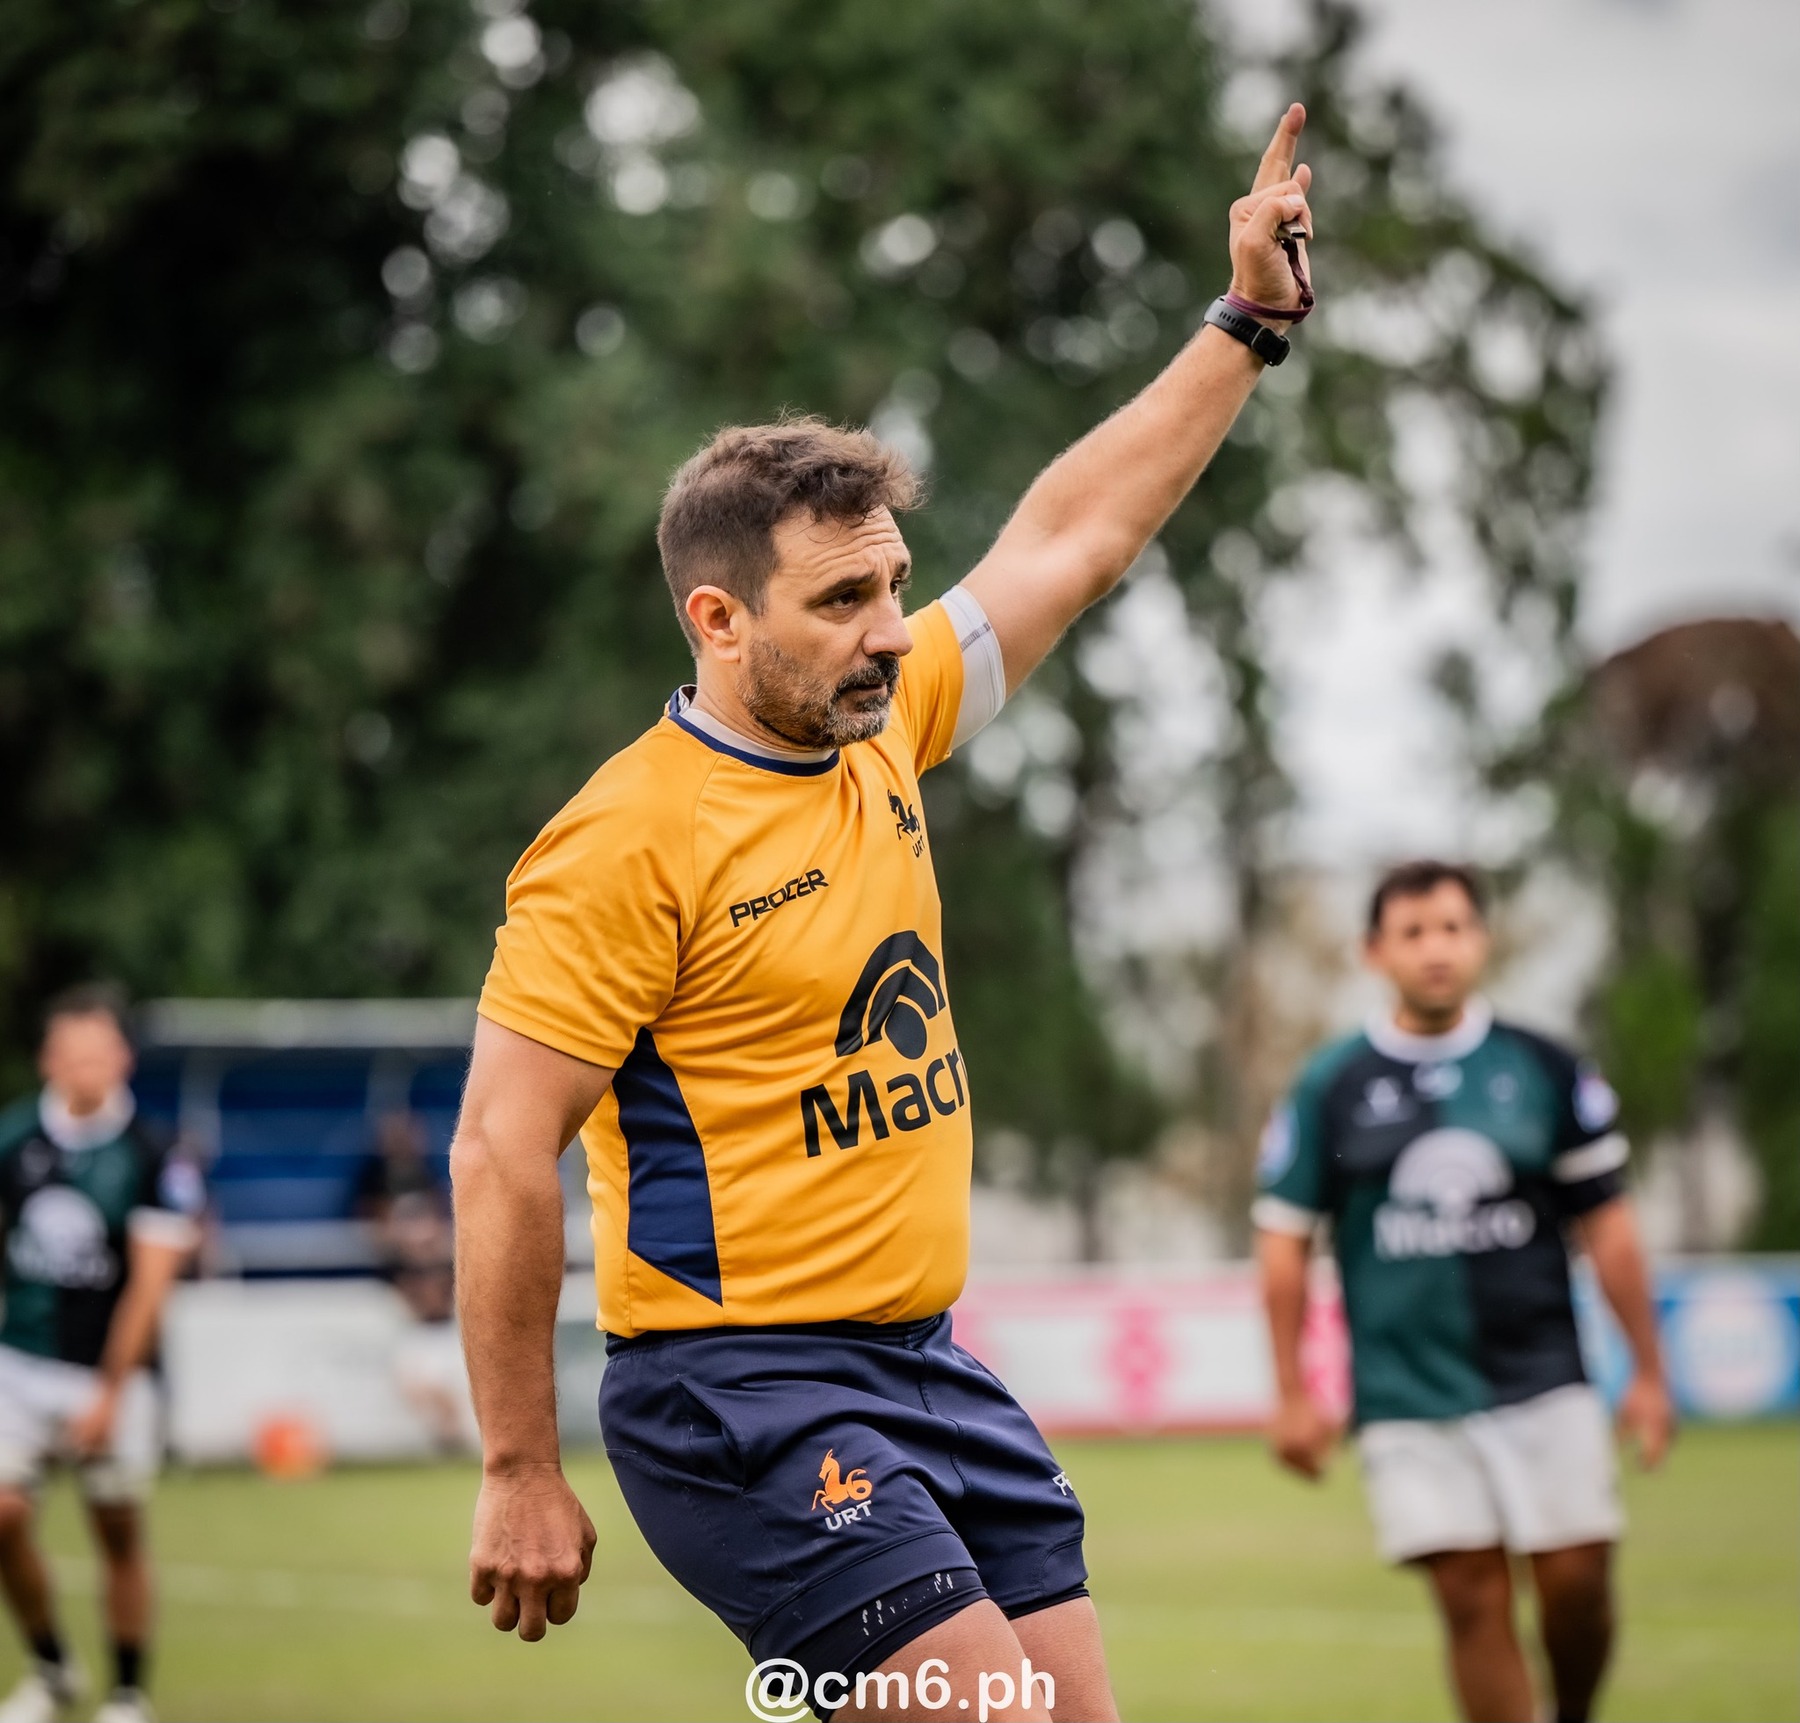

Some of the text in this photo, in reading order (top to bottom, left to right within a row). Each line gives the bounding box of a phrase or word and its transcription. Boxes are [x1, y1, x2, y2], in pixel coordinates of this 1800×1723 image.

[729, 868, 829, 928] PROCER
[800, 1046, 968, 1159] Macr
[824, 1499, 872, 1531] URT
